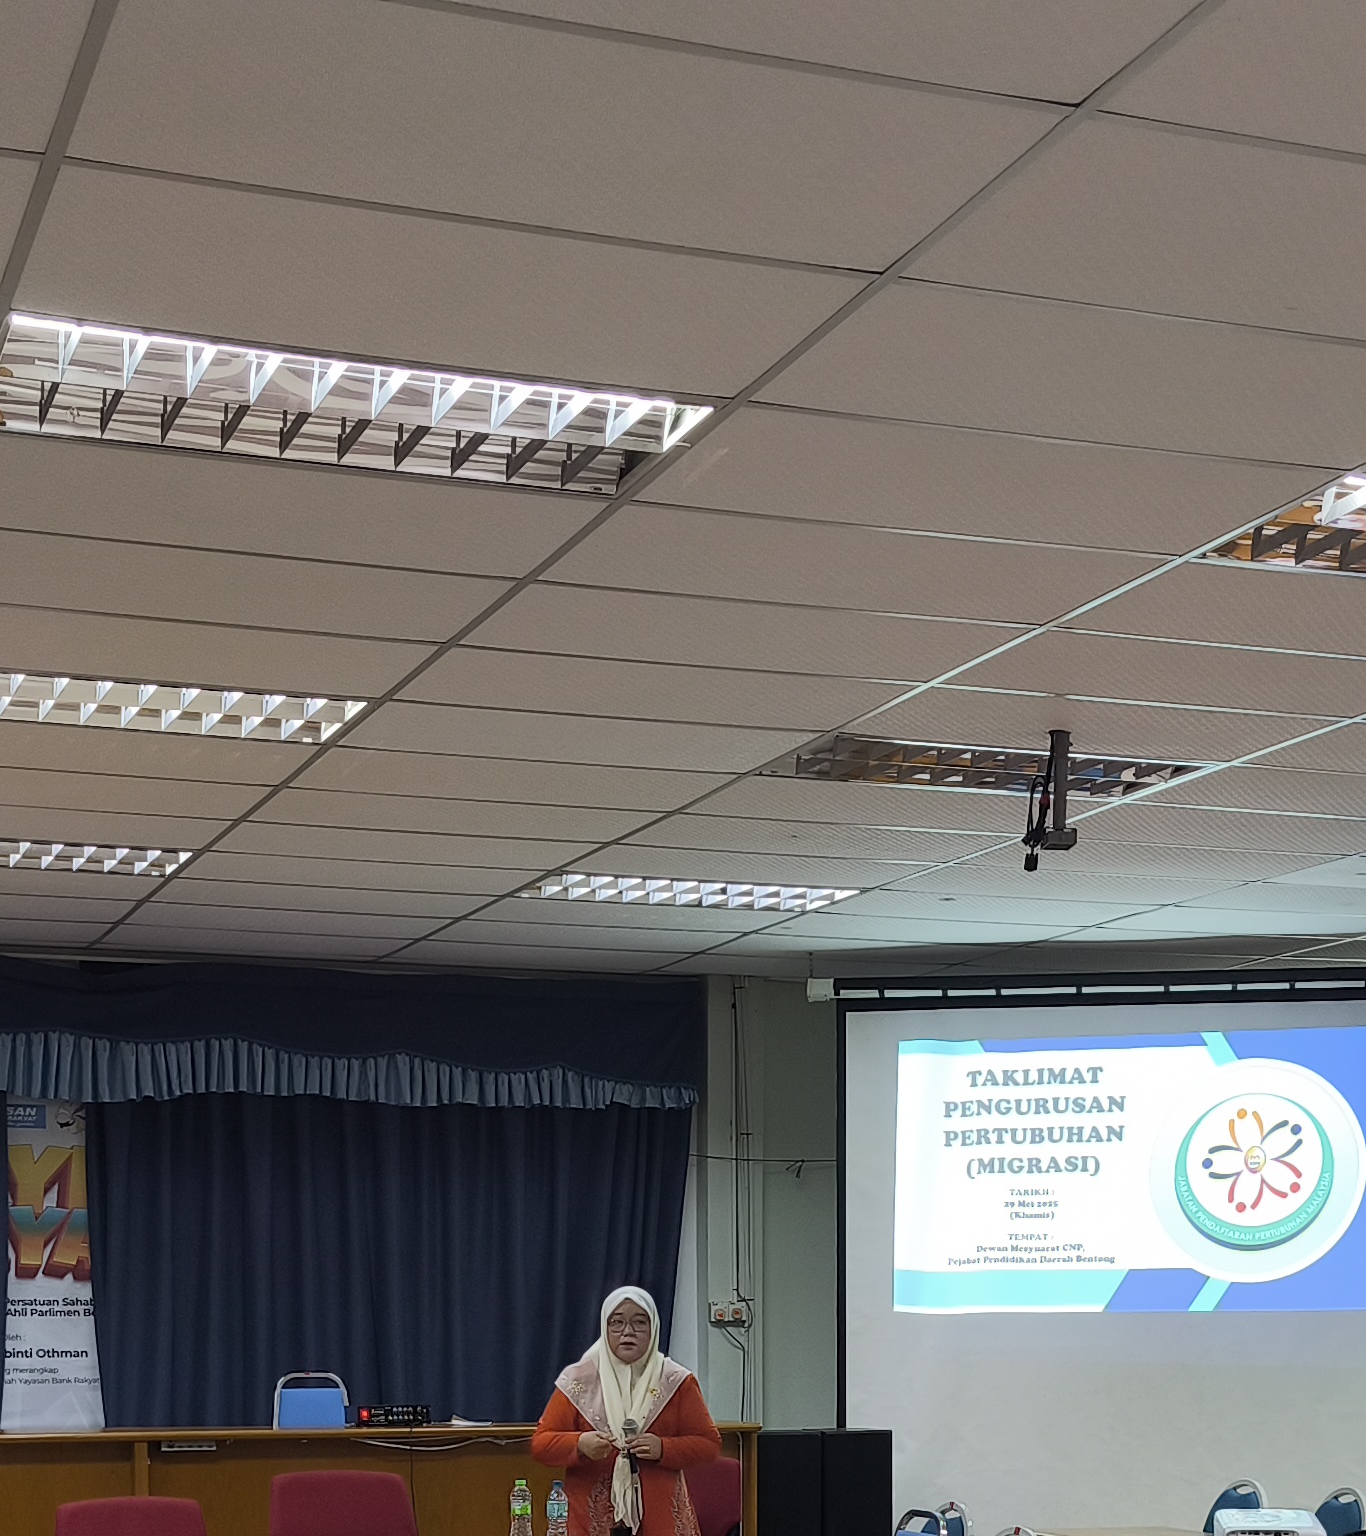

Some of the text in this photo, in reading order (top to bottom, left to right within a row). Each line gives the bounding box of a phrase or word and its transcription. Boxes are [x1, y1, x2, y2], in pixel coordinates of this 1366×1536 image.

[966, 1066, 1104, 1088] TAKLIMAT
[942, 1095, 1127, 1118] PENGURUSAN
[943, 1125, 1126, 1147] PERTUBUHAN
[966, 1155, 1101, 1180] (MIGRASI)
[1009, 1188, 1049, 1196] TARIKH
[1177, 1171, 1331, 1241] JABATAN PENDAFTARAN PERTUBUHAN MALAYSIA
[1007, 1233, 1049, 1241] TEMPAT
[6, 1307, 28, 1317] Ahli
[30, 1307, 80, 1317] Parlimen
[35, 1347, 89, 1359] Othman
[12, 1366, 59, 1375] merangkap
[18, 1377, 50, 1386] Yayasan
[51, 1377, 73, 1385] Bank
[74, 1377, 100, 1386] Rakyat
